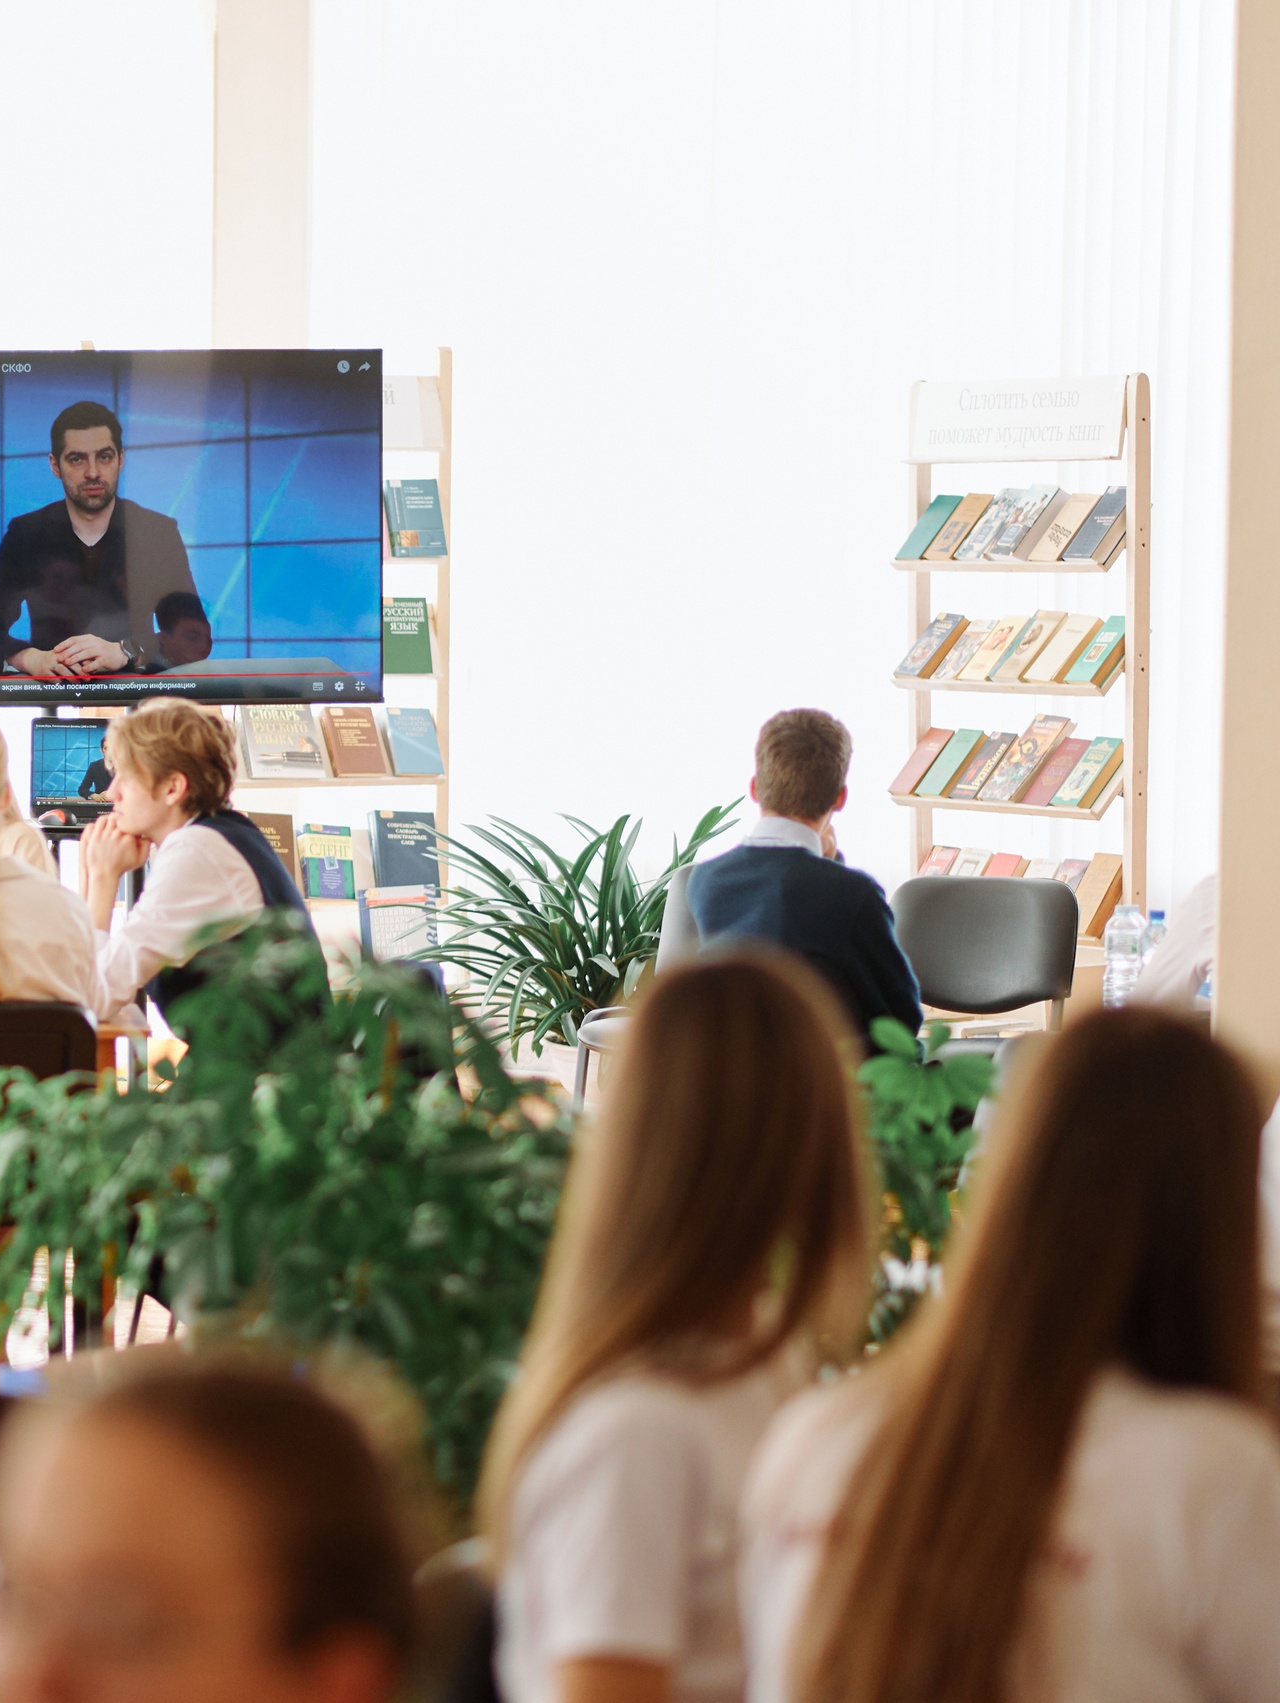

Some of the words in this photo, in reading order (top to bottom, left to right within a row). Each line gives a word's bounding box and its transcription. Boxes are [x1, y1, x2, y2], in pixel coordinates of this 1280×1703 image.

[1, 362, 32, 373] СКФО
[959, 388, 1028, 411] Сплотить
[1031, 390, 1080, 409] семью
[928, 426, 993, 445] поможет
[995, 425, 1064, 449] мудрость
[1067, 424, 1105, 442] книг
[383, 606, 424, 616] РУССКИЙ
[390, 622, 418, 631] ЯЗЫК
[43, 683, 66, 691] чтобы
[66, 683, 108, 692] посмотреть
[109, 681, 149, 692] подробную
[149, 681, 197, 691] информацию
[249, 709, 300, 721] СЛОВАРЬ
[252, 721, 308, 734] РУССКОГО
[255, 734, 294, 746] ЯЗЫКА
[310, 843, 350, 857] СЛЕНГ
